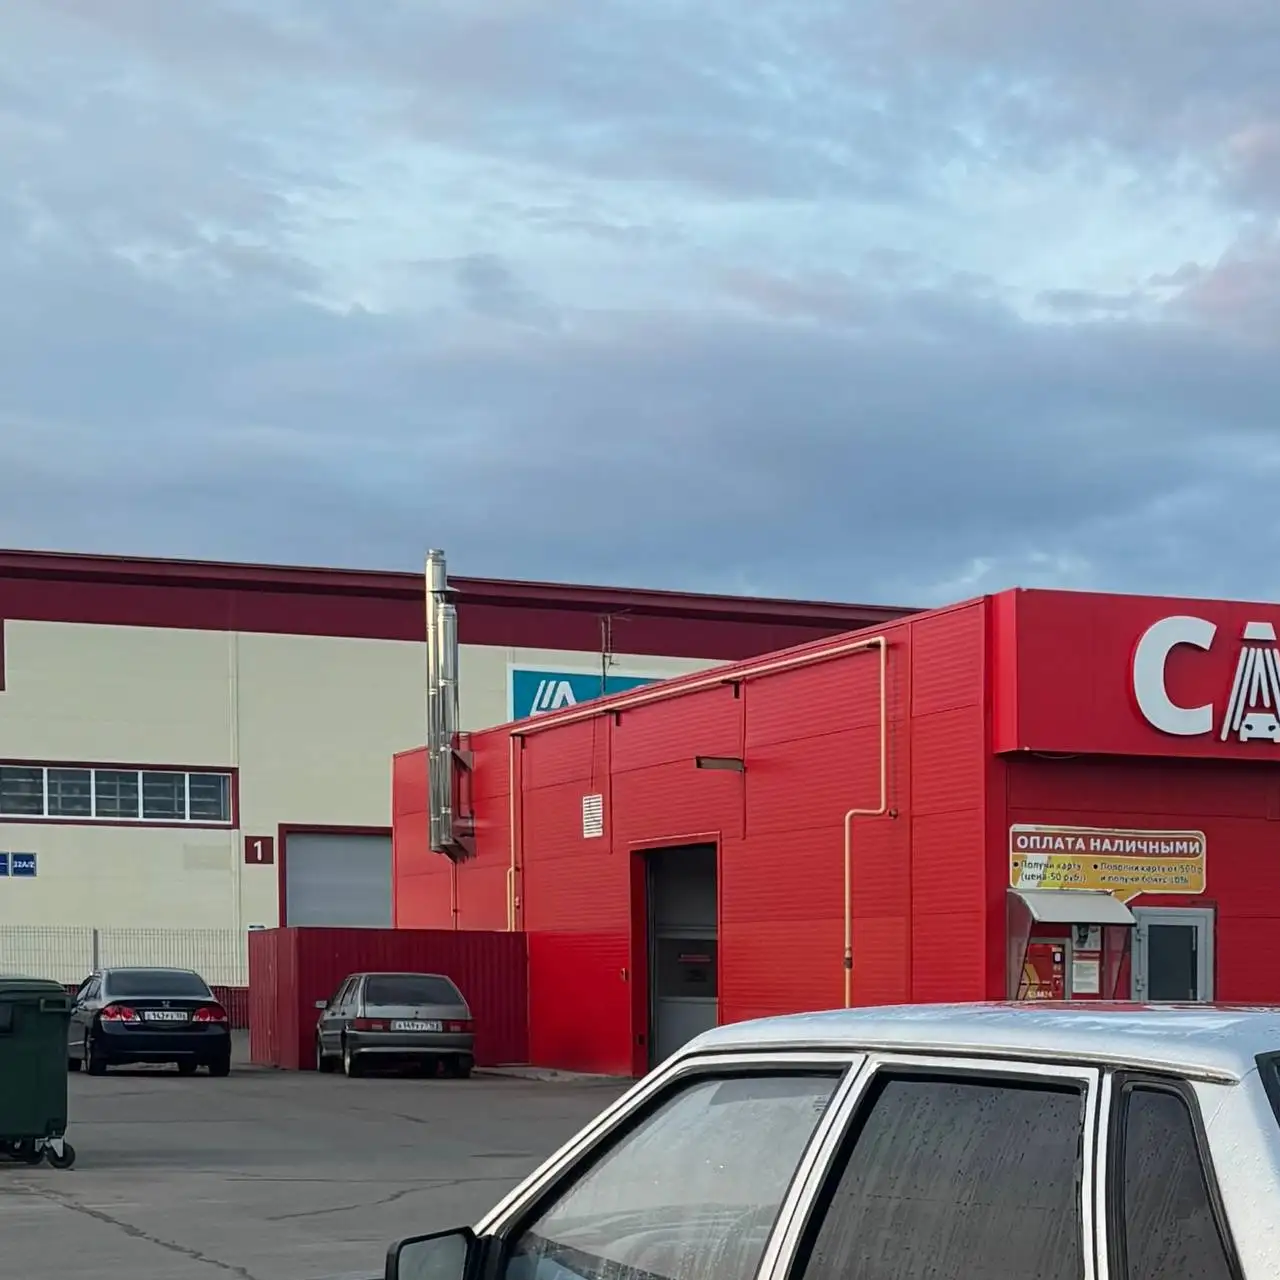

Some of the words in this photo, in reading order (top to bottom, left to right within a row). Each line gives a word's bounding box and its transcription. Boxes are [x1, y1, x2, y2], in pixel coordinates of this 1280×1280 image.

[253, 840, 262, 861] 1
[1016, 835, 1086, 851] ОПЛАТА
[1089, 838, 1200, 854] НАЛИЧНЫМИ
